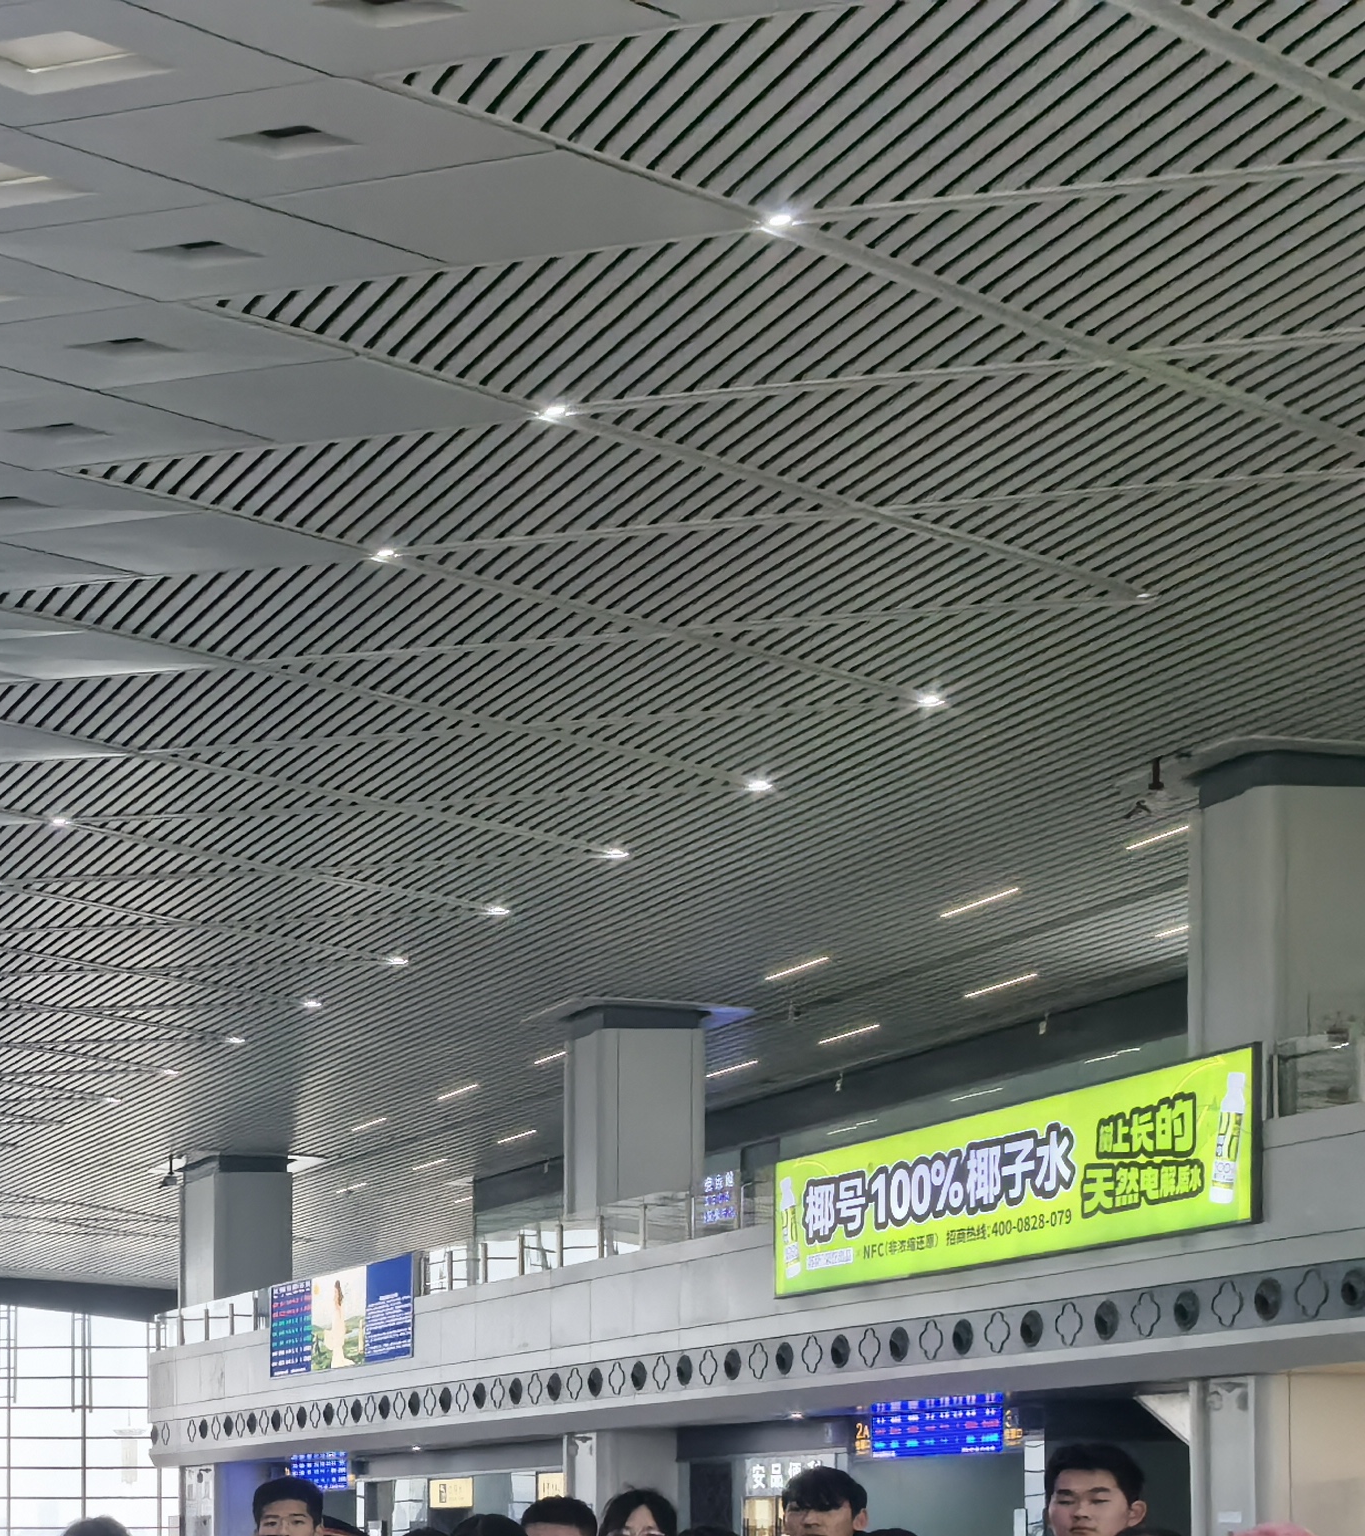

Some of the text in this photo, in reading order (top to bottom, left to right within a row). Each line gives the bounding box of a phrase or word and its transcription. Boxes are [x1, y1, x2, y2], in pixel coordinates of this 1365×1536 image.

[1098, 1096, 1195, 1155] 树上长的
[804, 1127, 1073, 1240] 椰号100%椰子水
[1082, 1164, 1203, 1215] 天然电解质水
[855, 1422, 870, 1439] 2A
[752, 1459, 822, 1490] 安品便
